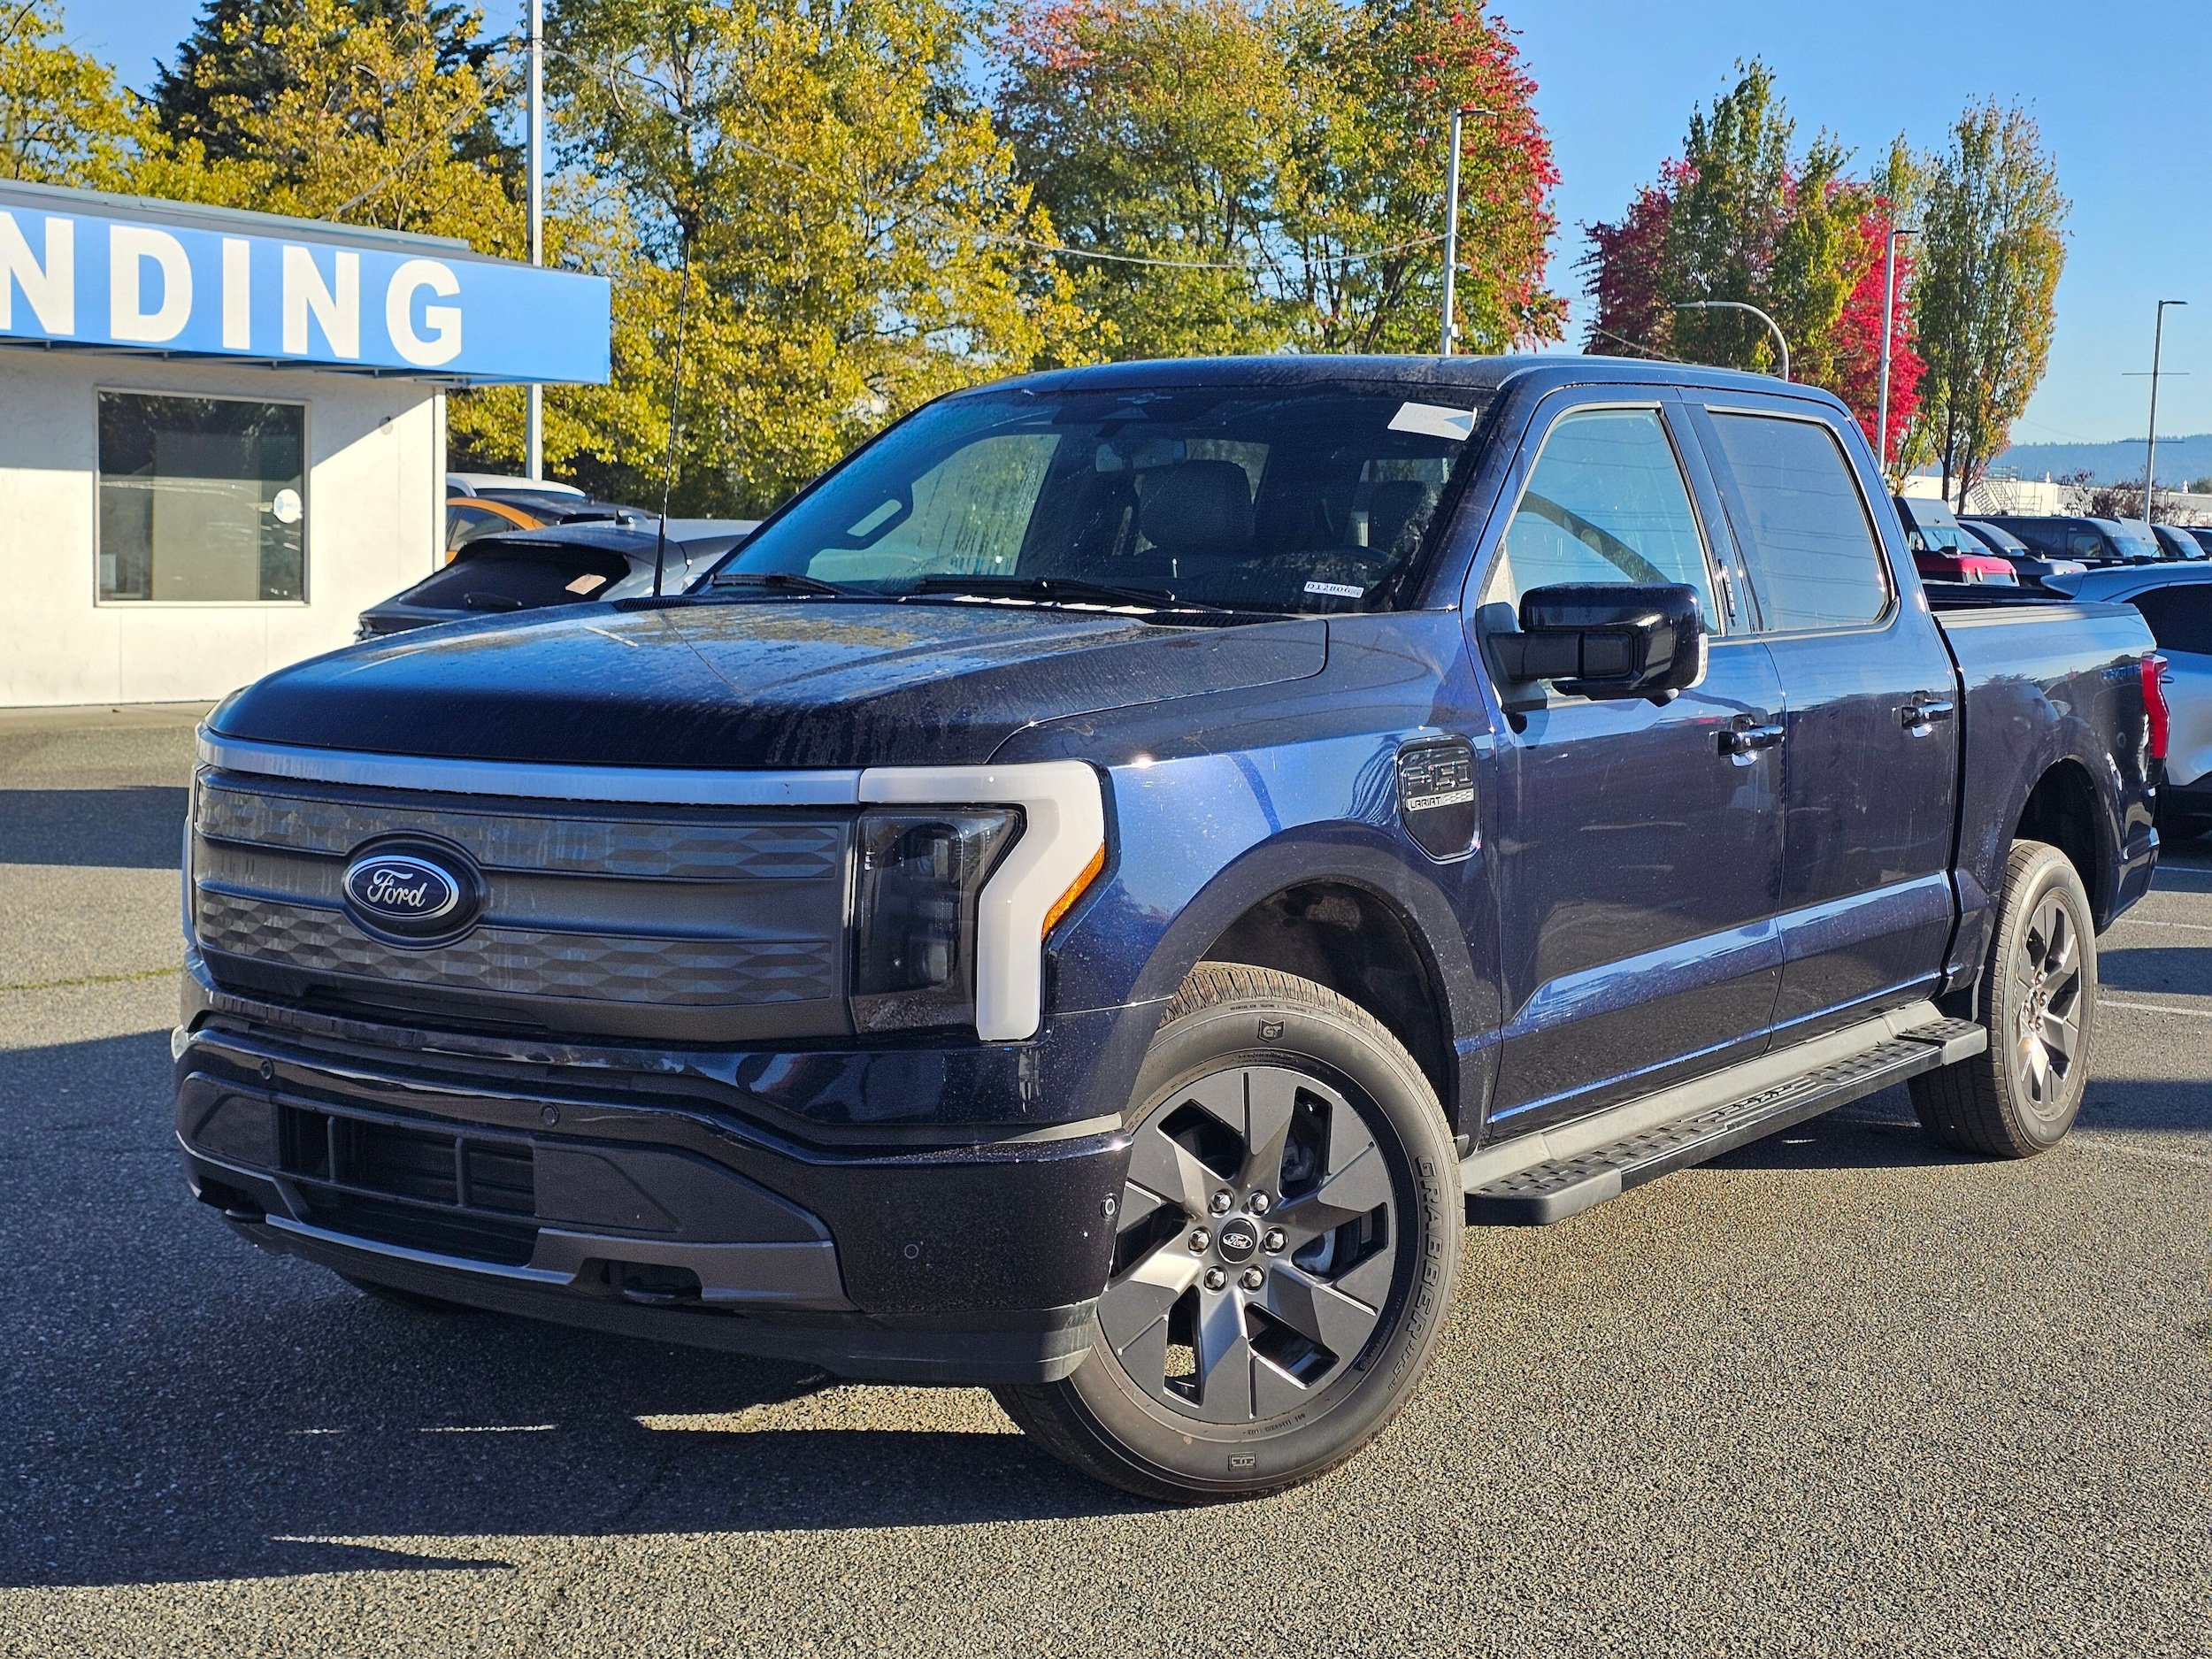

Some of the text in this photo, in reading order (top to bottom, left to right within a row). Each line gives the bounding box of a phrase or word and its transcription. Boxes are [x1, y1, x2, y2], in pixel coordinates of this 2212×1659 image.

[0, 211, 463, 367] NDING
[1410, 796, 1441, 809] LARIAT
[366, 868, 428, 908] Ford
[1405, 1156, 1444, 1340] GRABBER
